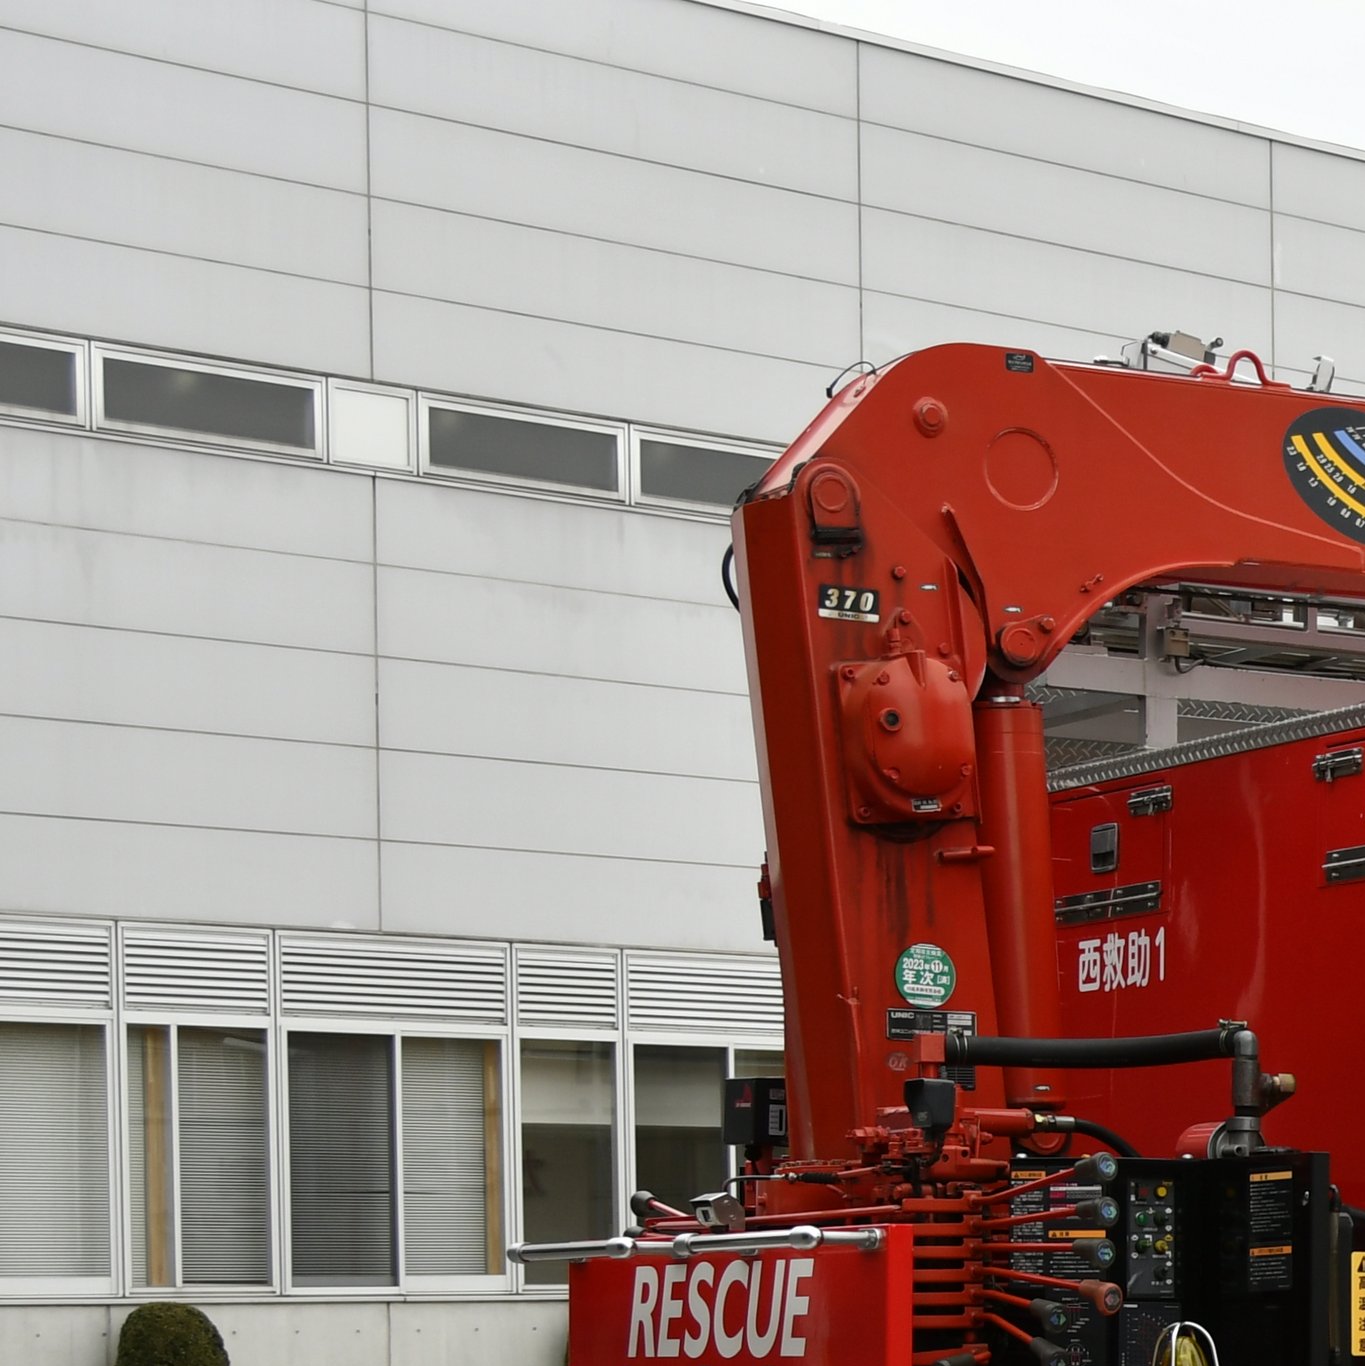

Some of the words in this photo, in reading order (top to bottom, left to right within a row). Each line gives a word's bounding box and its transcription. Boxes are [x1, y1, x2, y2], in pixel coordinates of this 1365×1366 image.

[825, 588, 875, 612] 370
[1079, 926, 1165, 992] 西救助1
[627, 1258, 815, 1359] RESCUE
